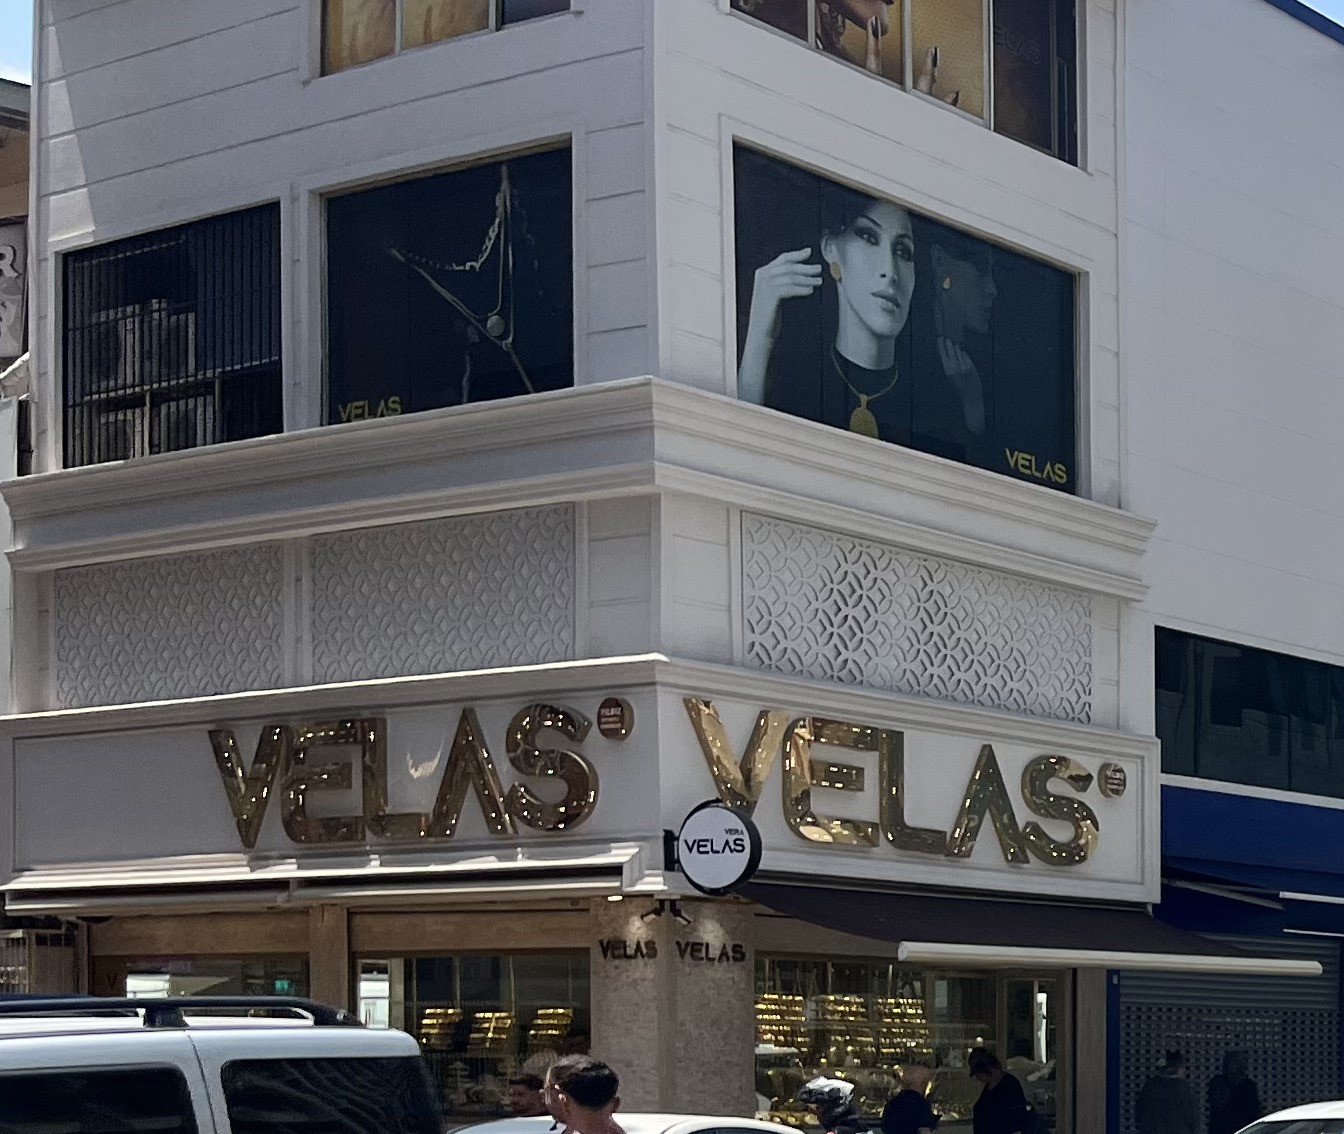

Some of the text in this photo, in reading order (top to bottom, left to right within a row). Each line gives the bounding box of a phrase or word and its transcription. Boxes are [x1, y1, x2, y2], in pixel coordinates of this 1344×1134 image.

[338, 396, 402, 421] VELAS
[1004, 447, 1067, 484] VELAS
[208, 703, 600, 849] VELAS
[682, 696, 1100, 866] VELAS
[683, 838, 746, 855] VELAS
[598, 940, 658, 960] VELAS
[675, 940, 746, 963] VELAS
